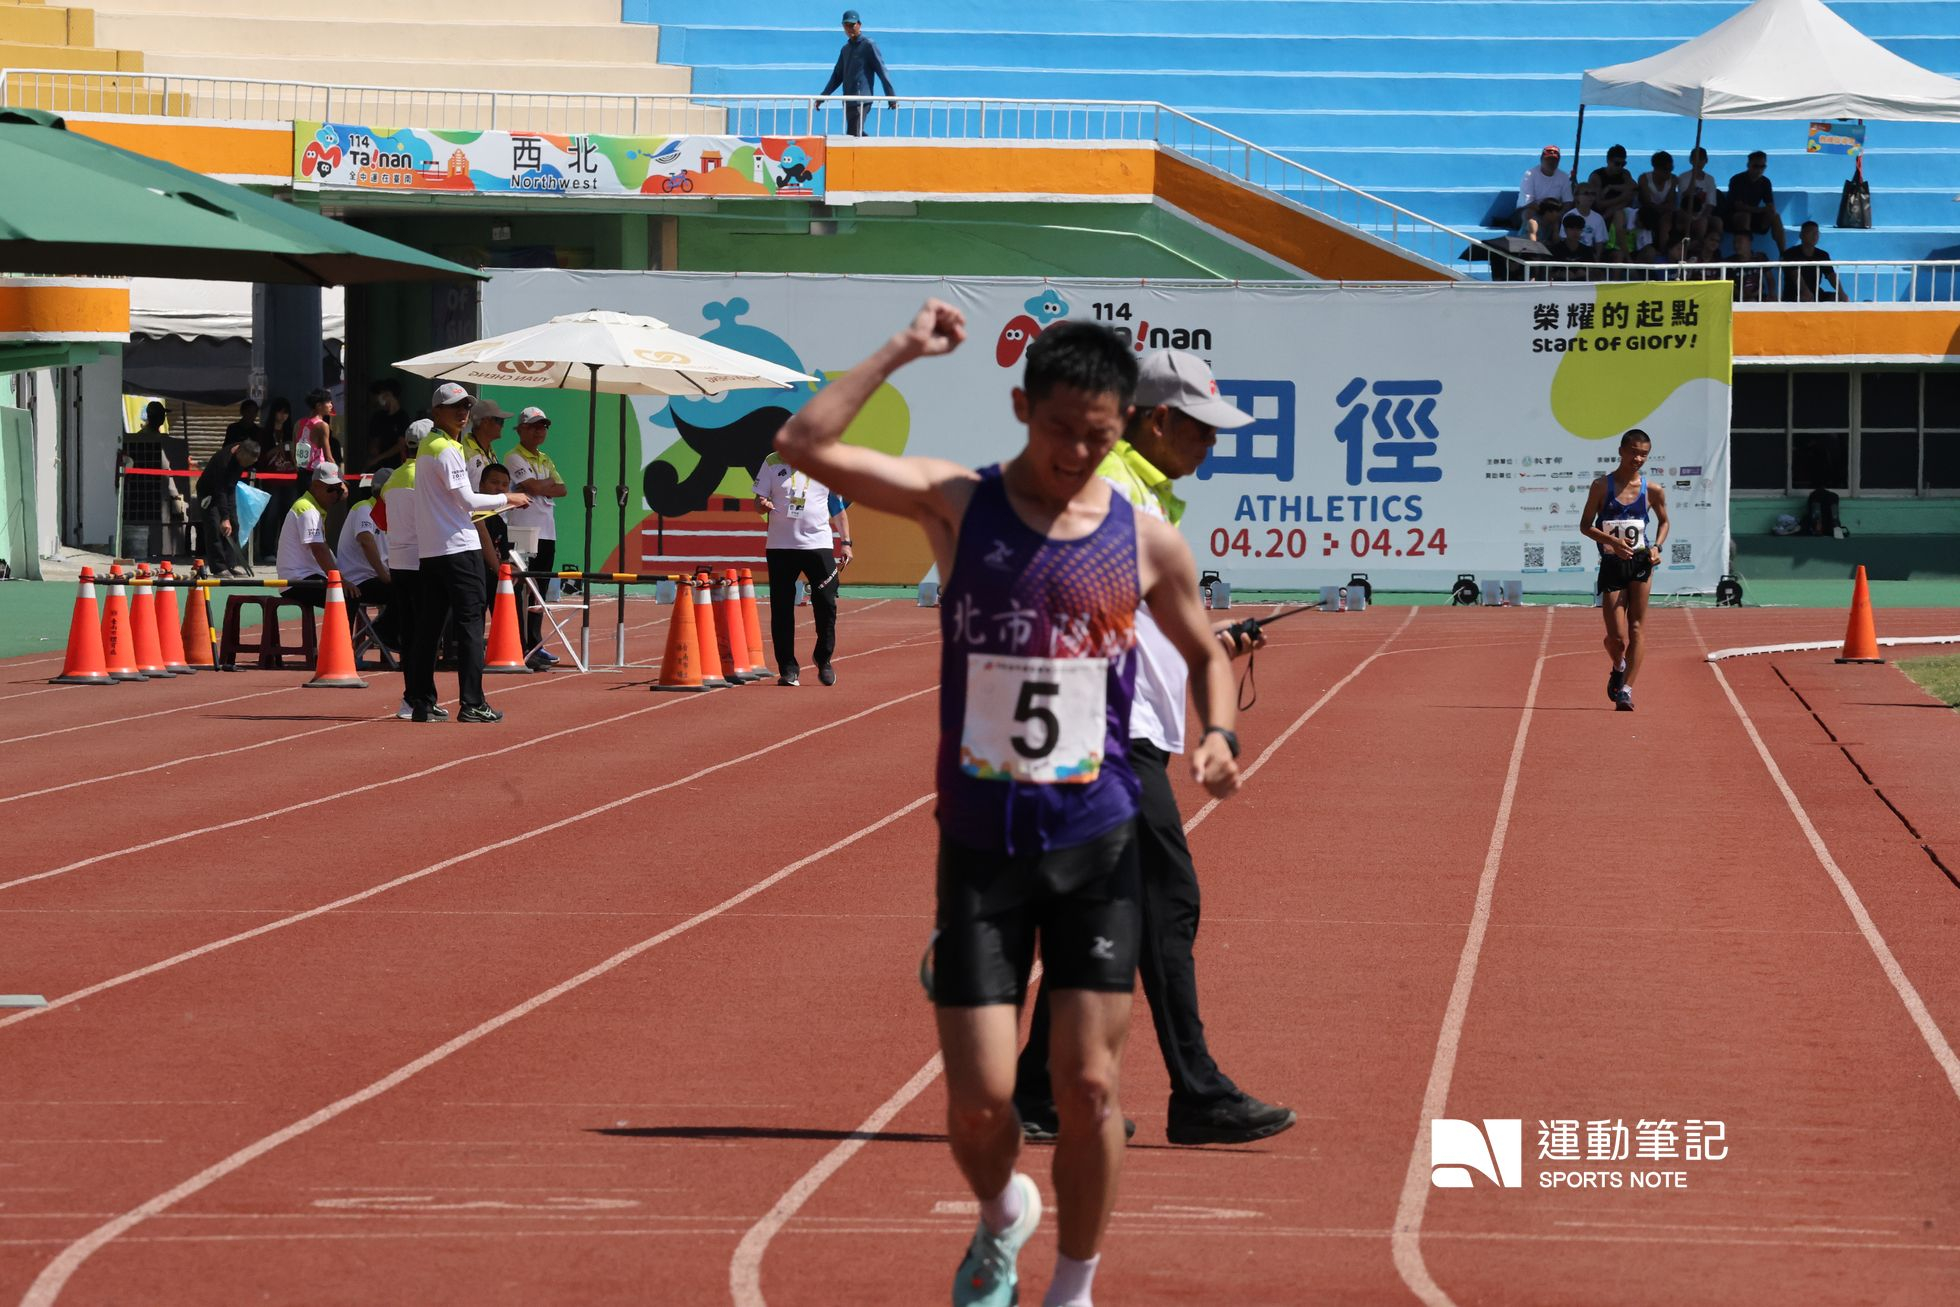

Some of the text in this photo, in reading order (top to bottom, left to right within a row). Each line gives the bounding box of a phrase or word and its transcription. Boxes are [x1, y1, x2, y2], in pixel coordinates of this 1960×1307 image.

[349, 134, 370, 148] 114
[512, 137, 598, 173] 西北
[511, 174, 598, 190] Northwest
[1092, 302, 1133, 321] 114
[1532, 299, 1699, 331] 榮耀的起點
[1532, 336, 1588, 353] Start
[1196, 377, 1442, 486] 田徑
[1234, 495, 1423, 523] ATHLETICS
[1210, 527, 1448, 558] 04.20 04.24
[1608, 525, 1639, 548] 19
[1010, 681, 1060, 760] 5
